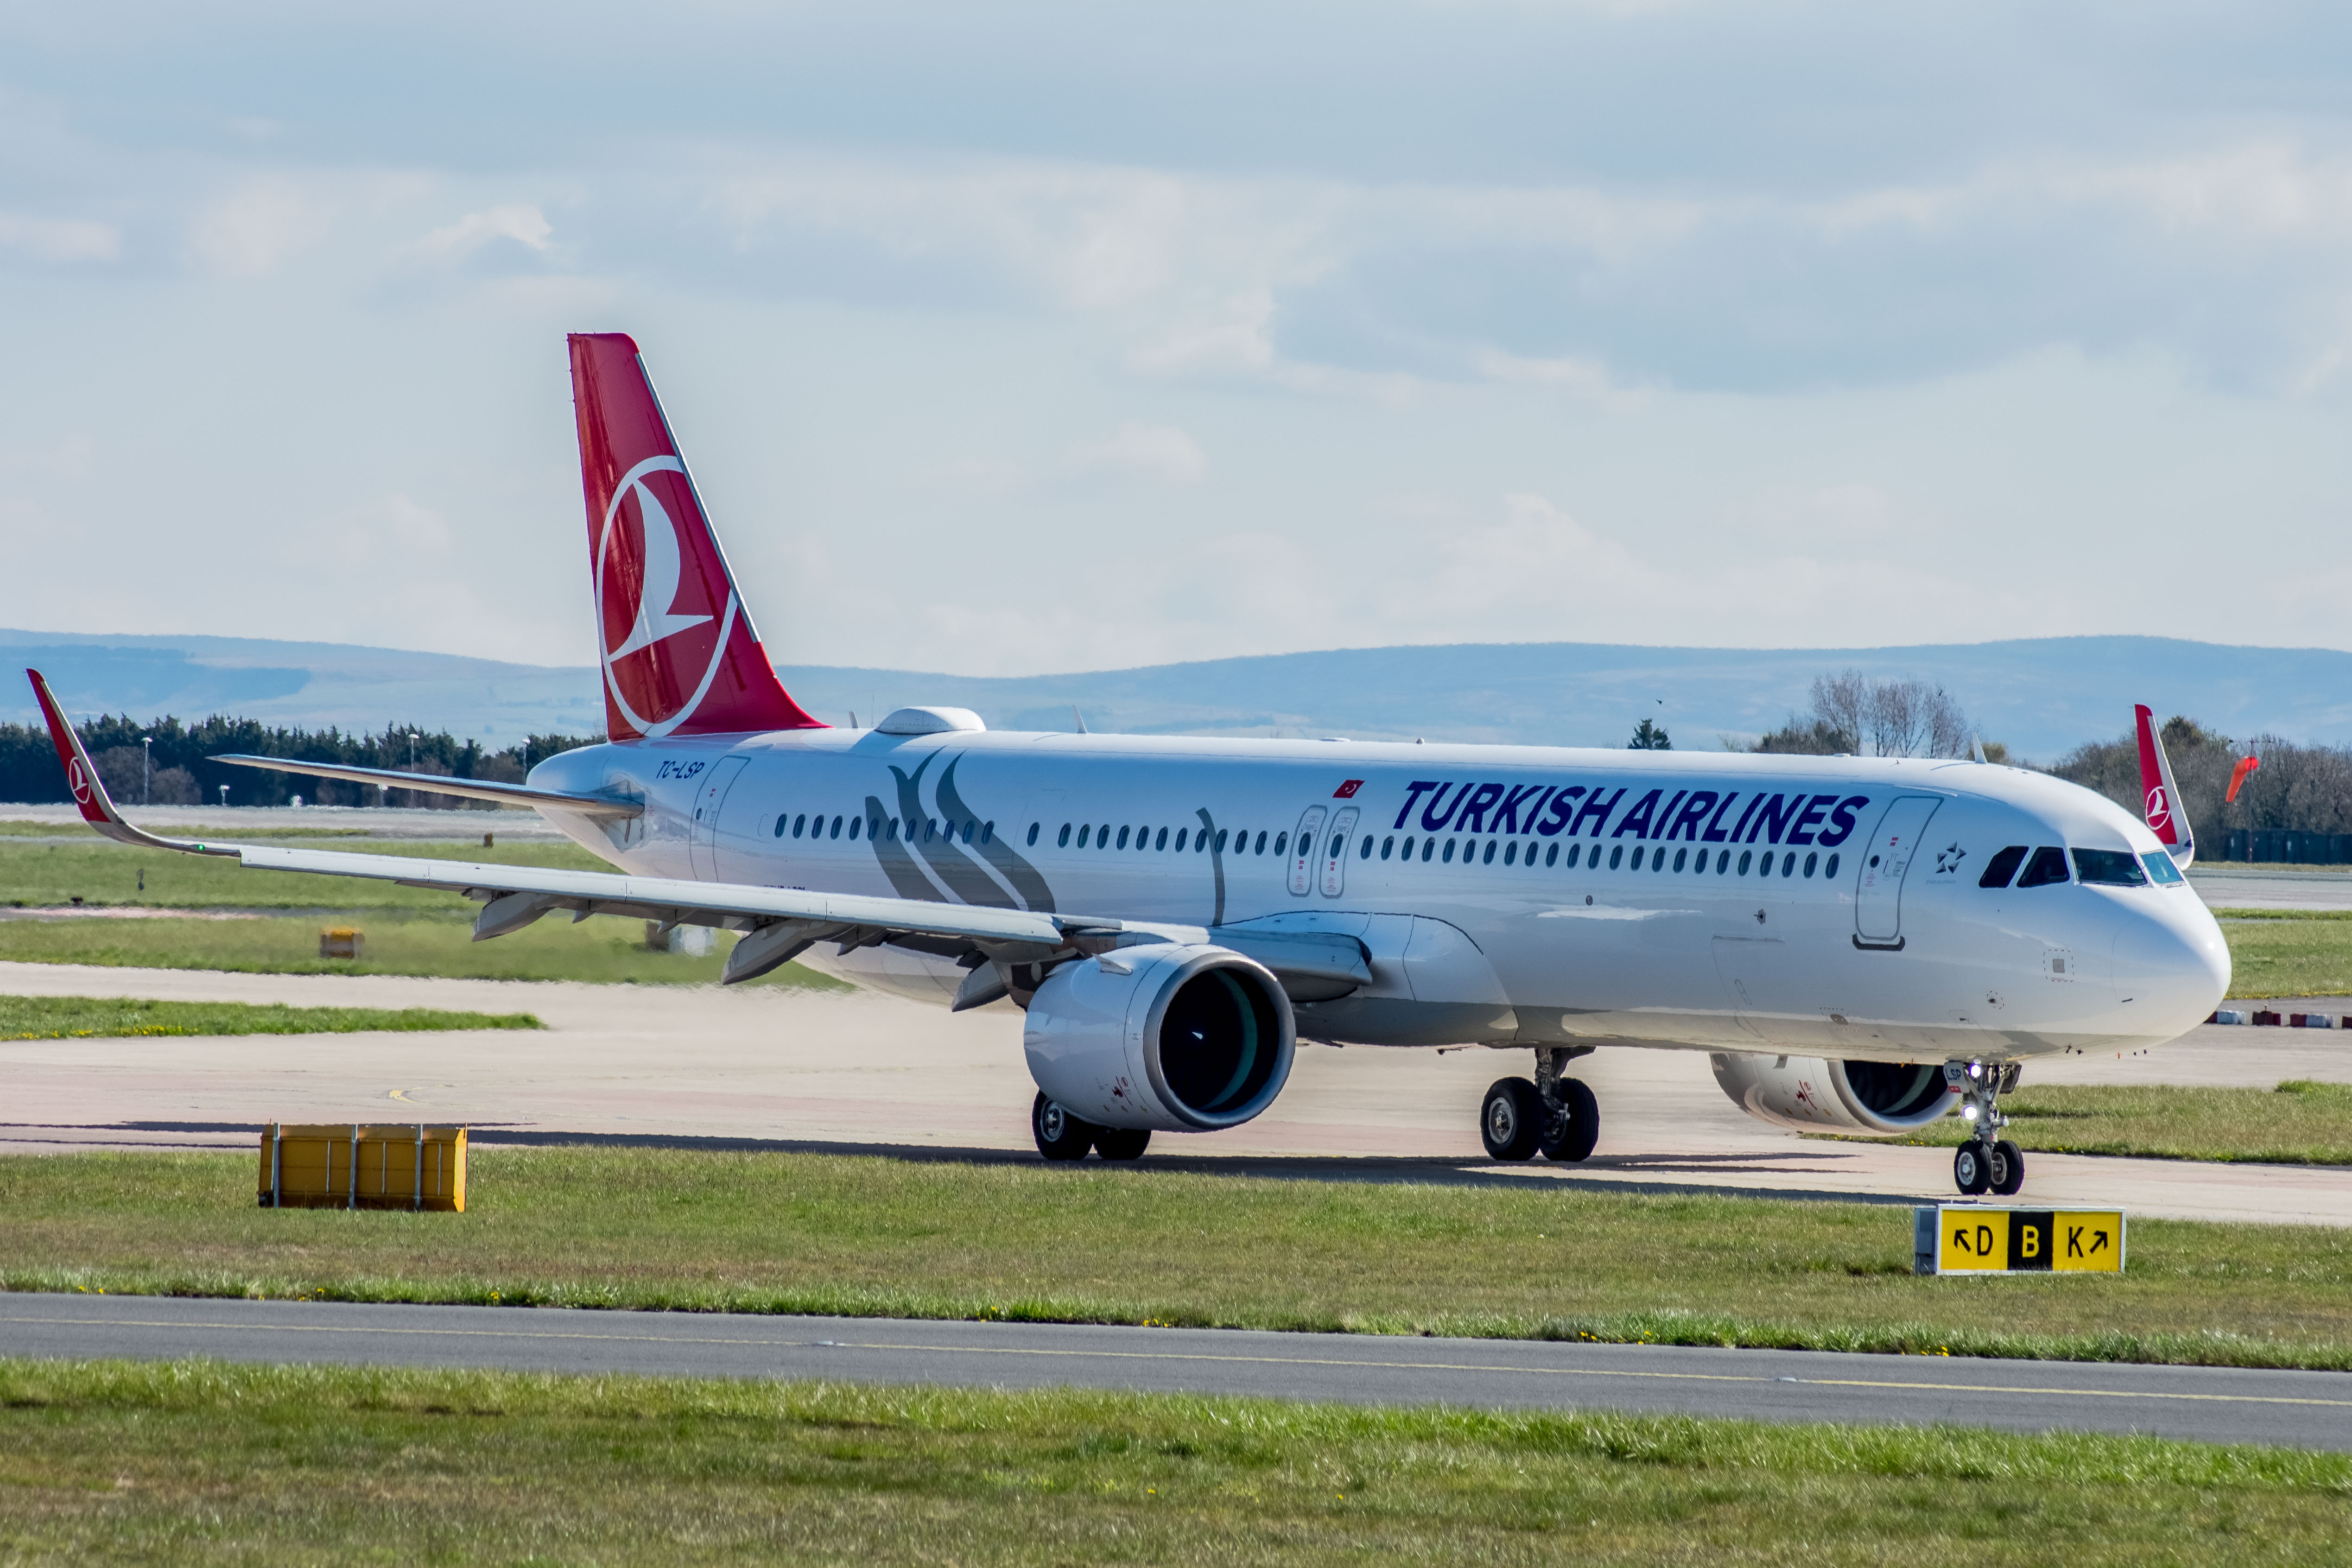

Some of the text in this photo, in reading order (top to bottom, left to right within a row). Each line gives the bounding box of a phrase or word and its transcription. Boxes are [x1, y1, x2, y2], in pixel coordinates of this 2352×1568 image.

[656, 761, 705, 779] TC-LSP
[1393, 781, 1870, 847] TURKISH AIRLINES
[1945, 1068, 1962, 1081] LSP
[1977, 1225, 2084, 1258] D B K
